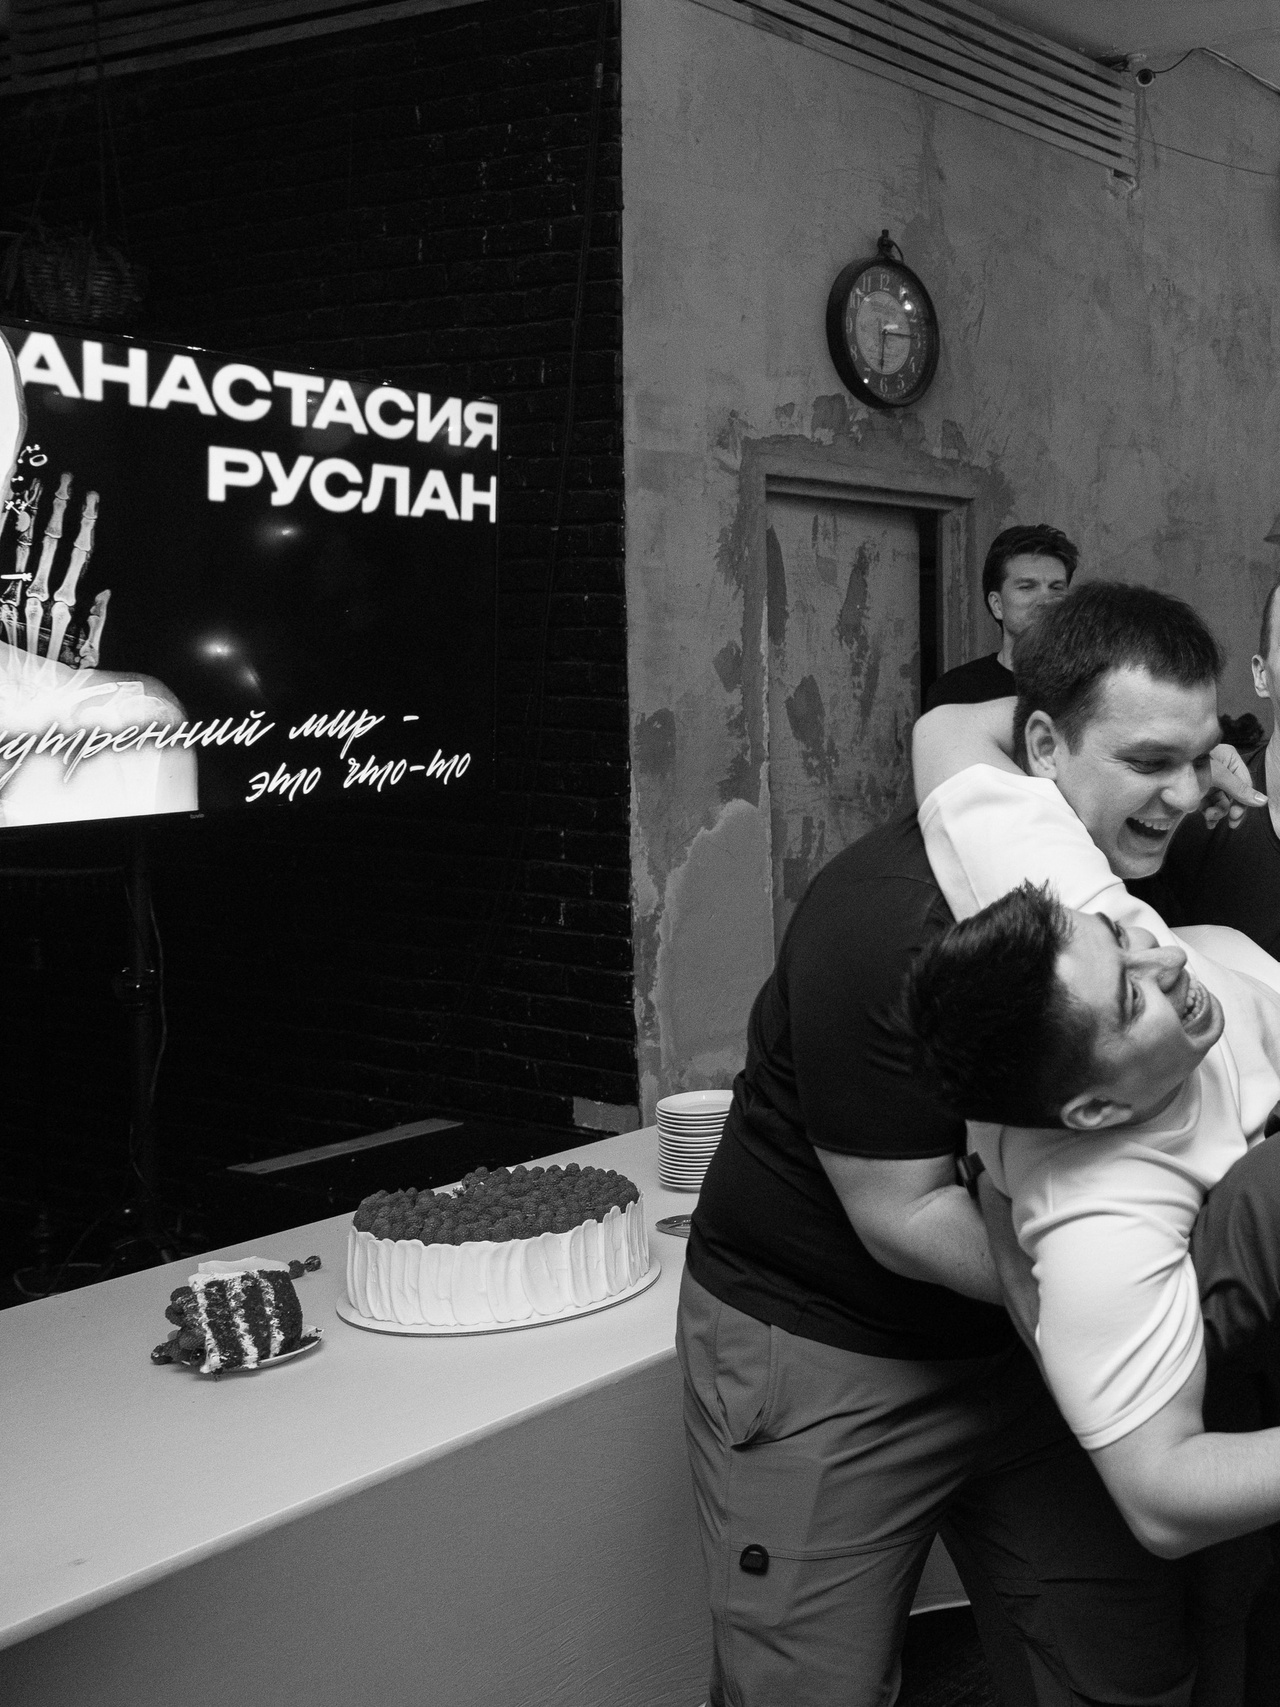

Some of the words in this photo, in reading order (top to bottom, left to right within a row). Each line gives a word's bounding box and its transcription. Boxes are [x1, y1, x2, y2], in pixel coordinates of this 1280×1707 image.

[863, 274, 872, 292] 11
[879, 273, 891, 292] 12
[849, 291, 861, 309] 10
[845, 316, 853, 333] 9
[913, 332, 921, 349] 3
[850, 344, 858, 362] 8
[908, 356, 916, 373] 4
[879, 377, 889, 394] 6
[897, 373, 905, 390] 5
[16, 332, 498, 451] АНАСТАСИЯ
[208, 445, 497, 523] РУСЛАН
[0, 709, 276, 790] утренний
[288, 708, 386, 760] мир
[245, 762, 322, 802] это
[343, 748, 471, 792] что-то
